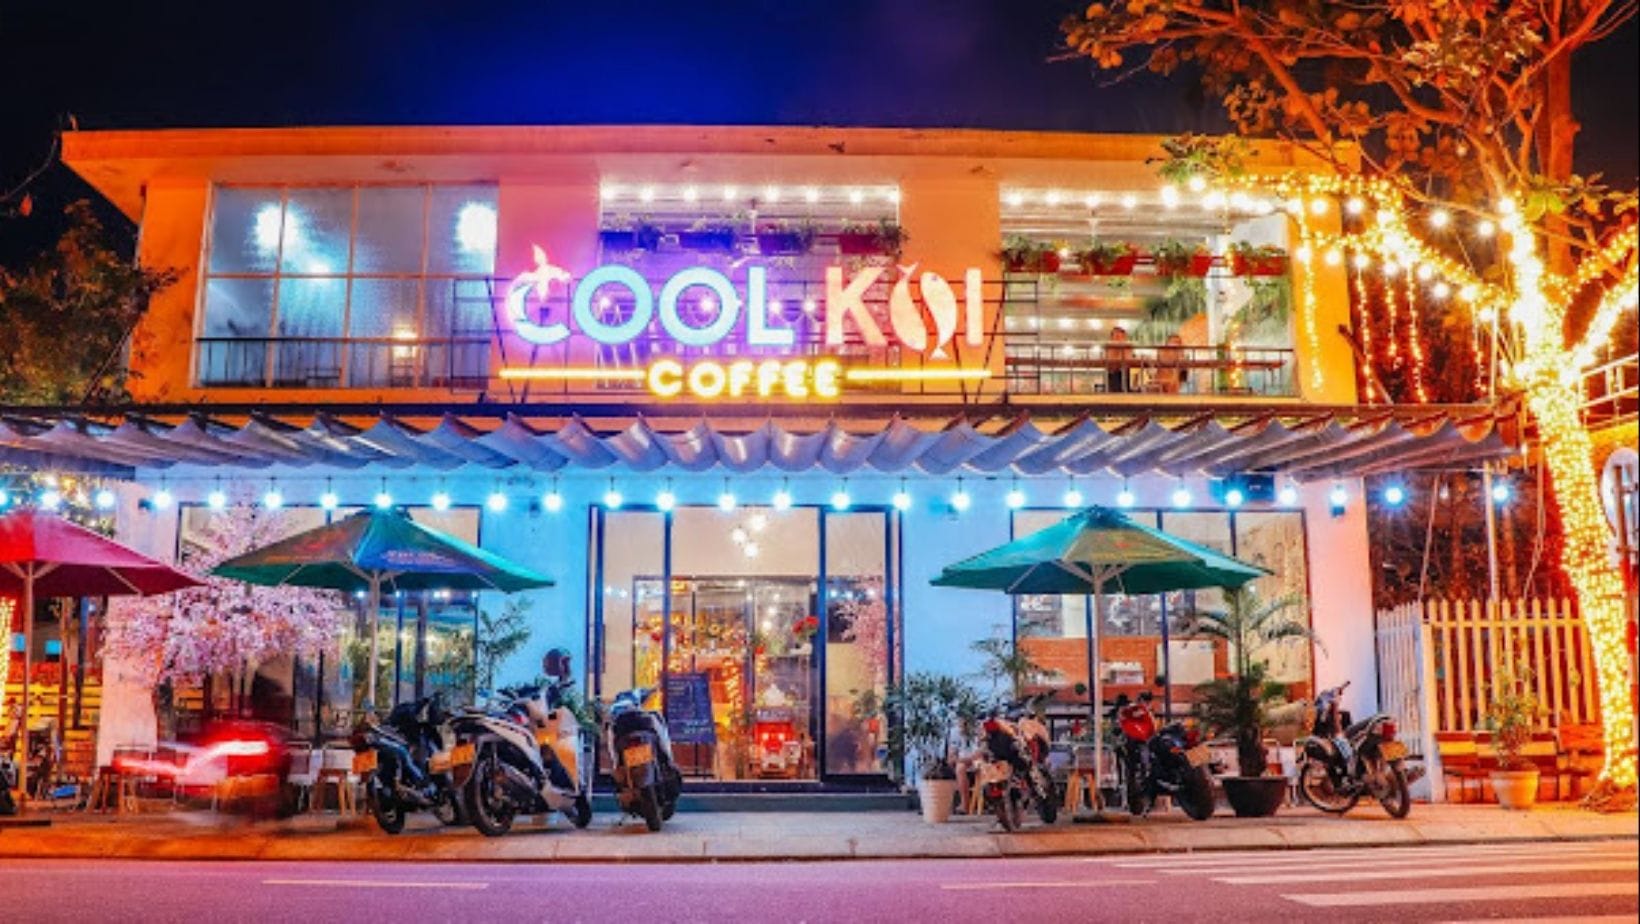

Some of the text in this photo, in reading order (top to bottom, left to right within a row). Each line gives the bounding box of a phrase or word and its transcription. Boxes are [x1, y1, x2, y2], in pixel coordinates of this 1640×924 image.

[506, 246, 985, 359] COOL KOI
[647, 360, 841, 397] COFFEE
